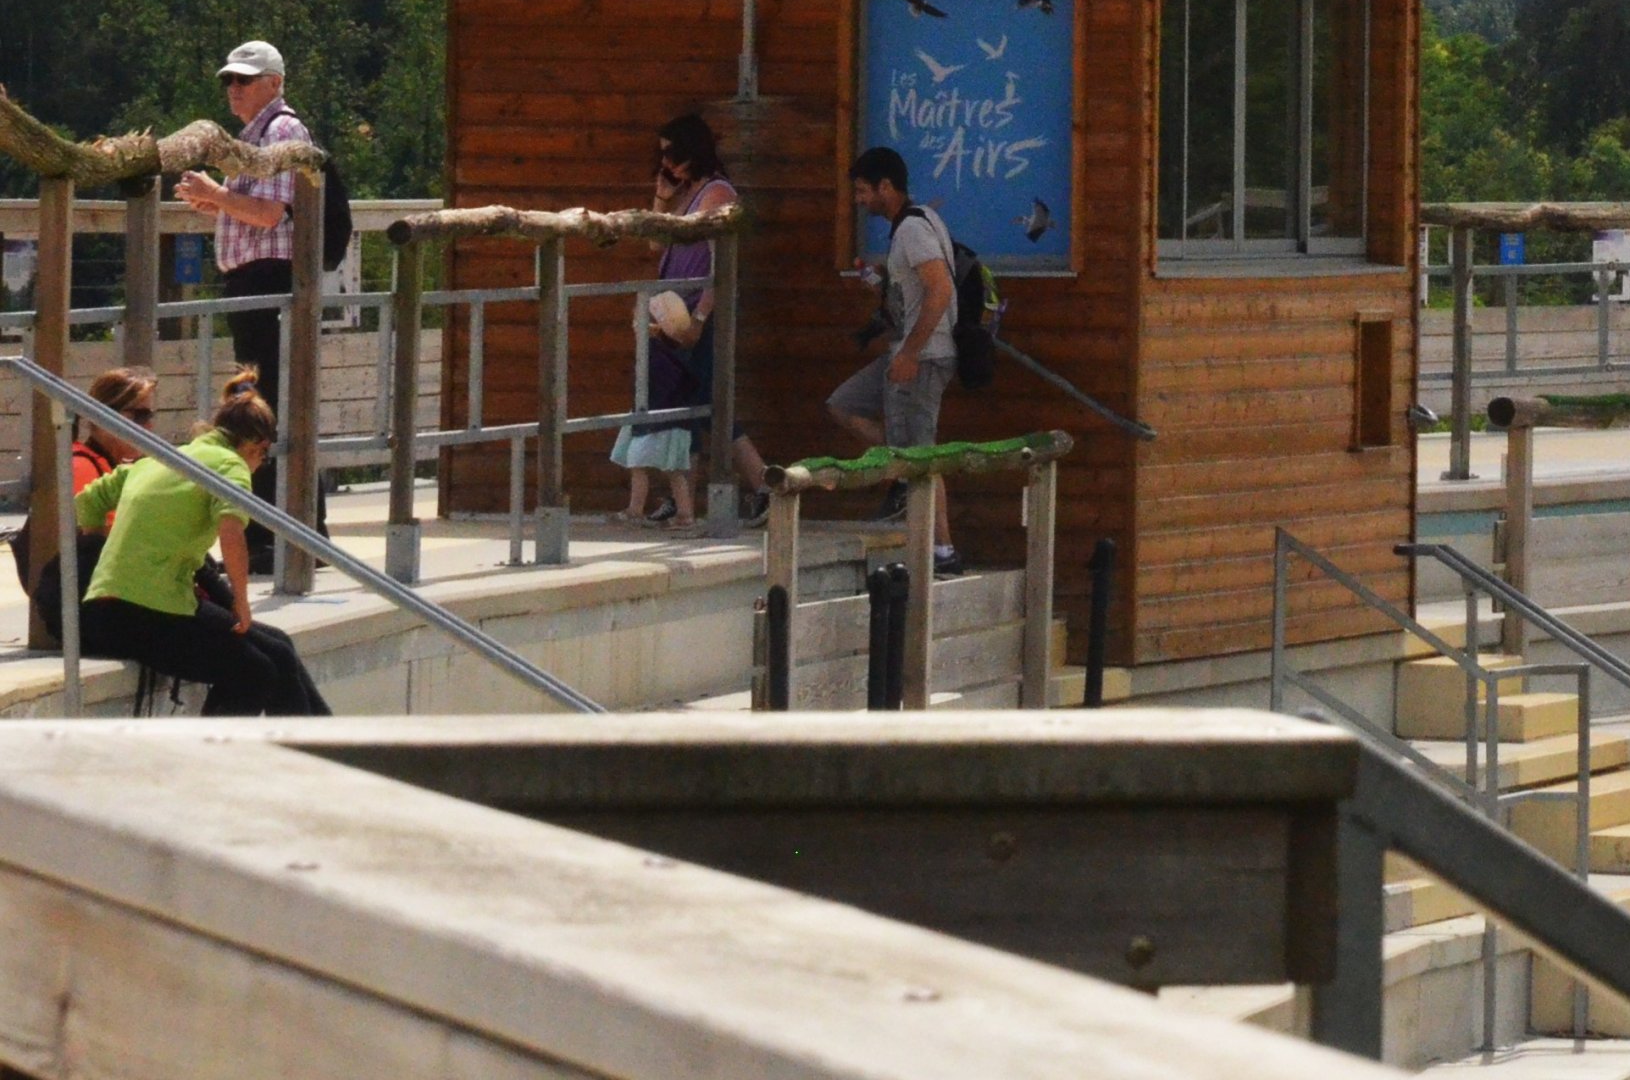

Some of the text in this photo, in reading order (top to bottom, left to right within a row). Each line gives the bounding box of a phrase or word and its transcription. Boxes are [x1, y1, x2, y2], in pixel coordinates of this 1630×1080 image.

[891, 69, 917, 87] Les
[889, 80, 1022, 140] Maîtres
[932, 125, 1047, 192] Airs
